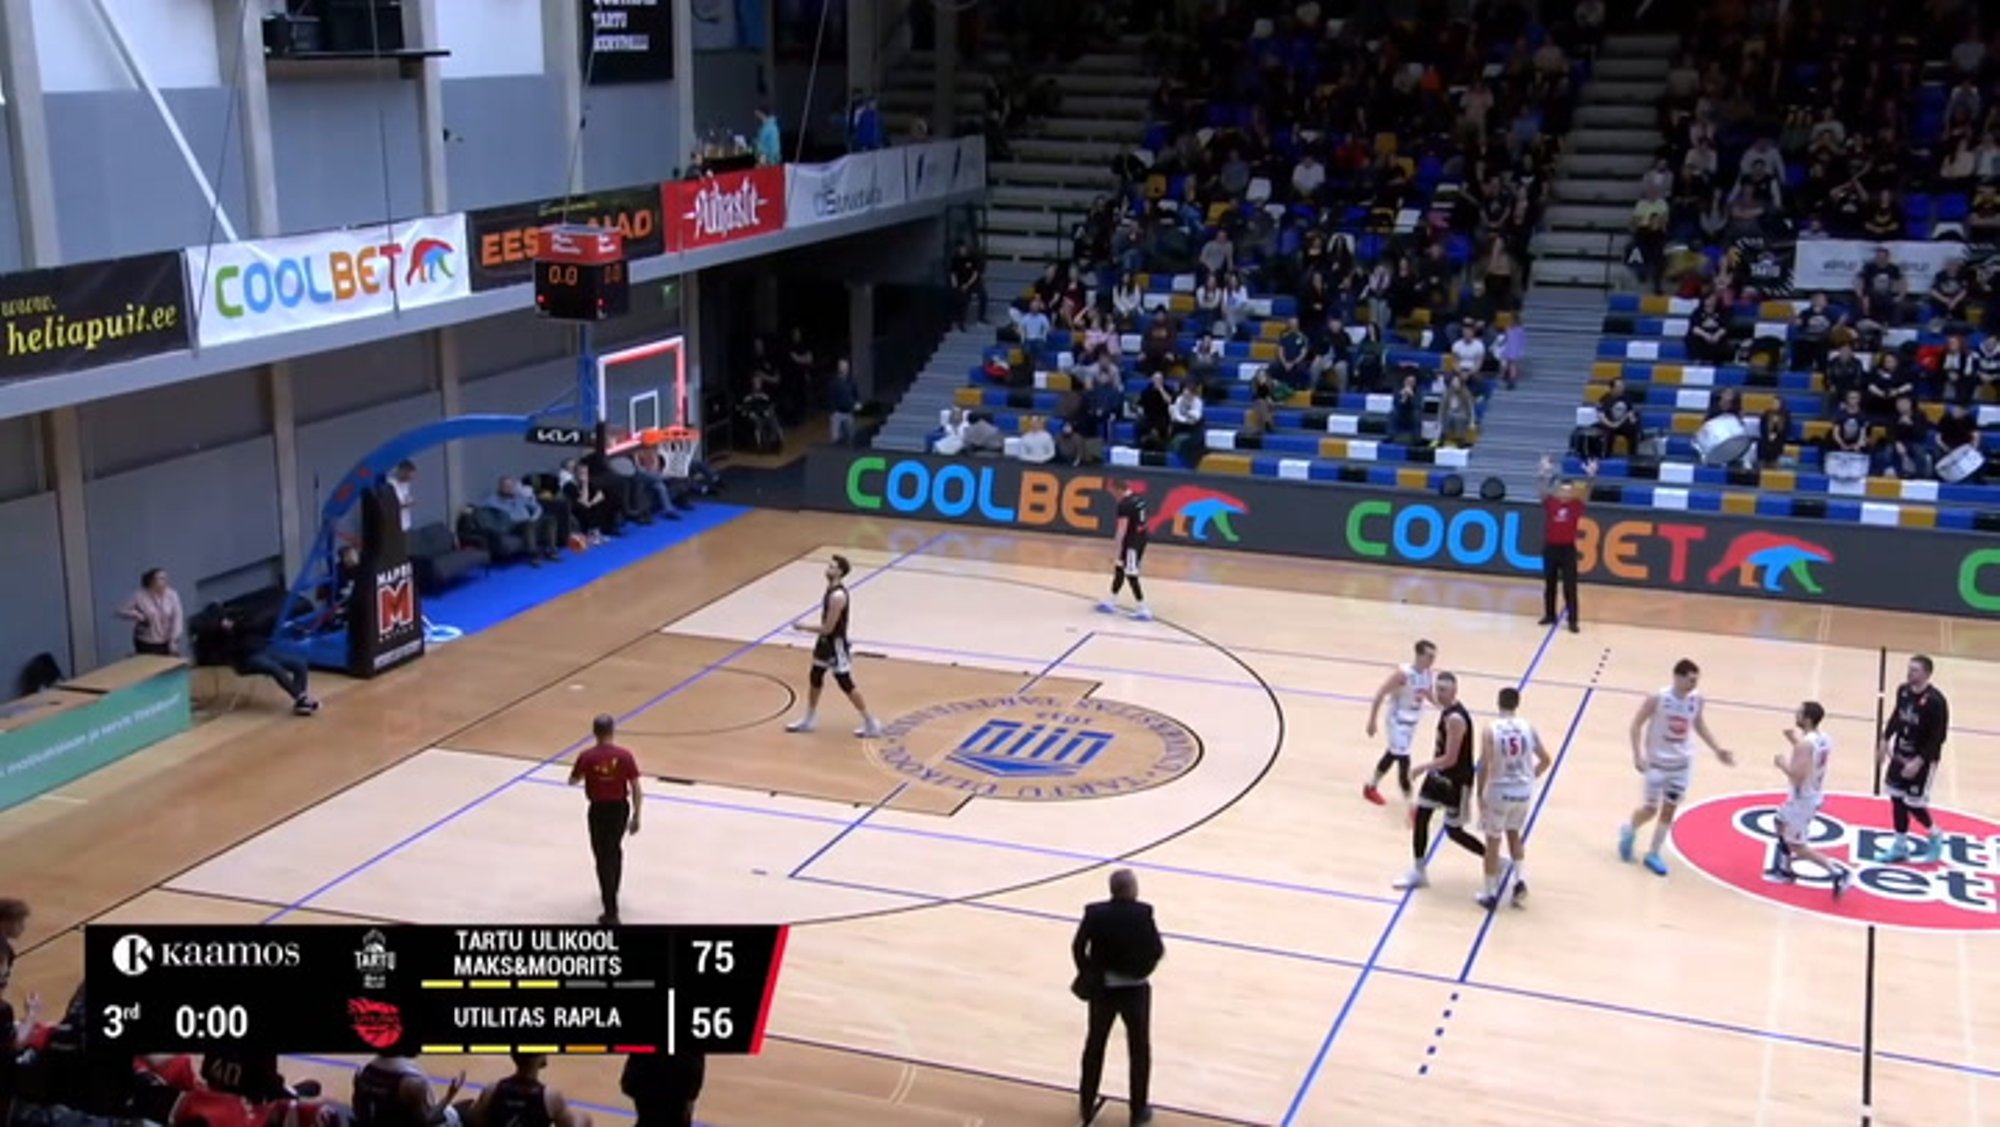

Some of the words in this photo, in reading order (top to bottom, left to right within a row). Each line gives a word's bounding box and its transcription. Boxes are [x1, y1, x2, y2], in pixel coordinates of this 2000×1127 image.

[214, 243, 403, 318] COOLBET
[7, 303, 177, 355] heliapuit.ee
[846, 457, 1147, 529] COOLBE
[1741, 808, 2000, 868] Opt
